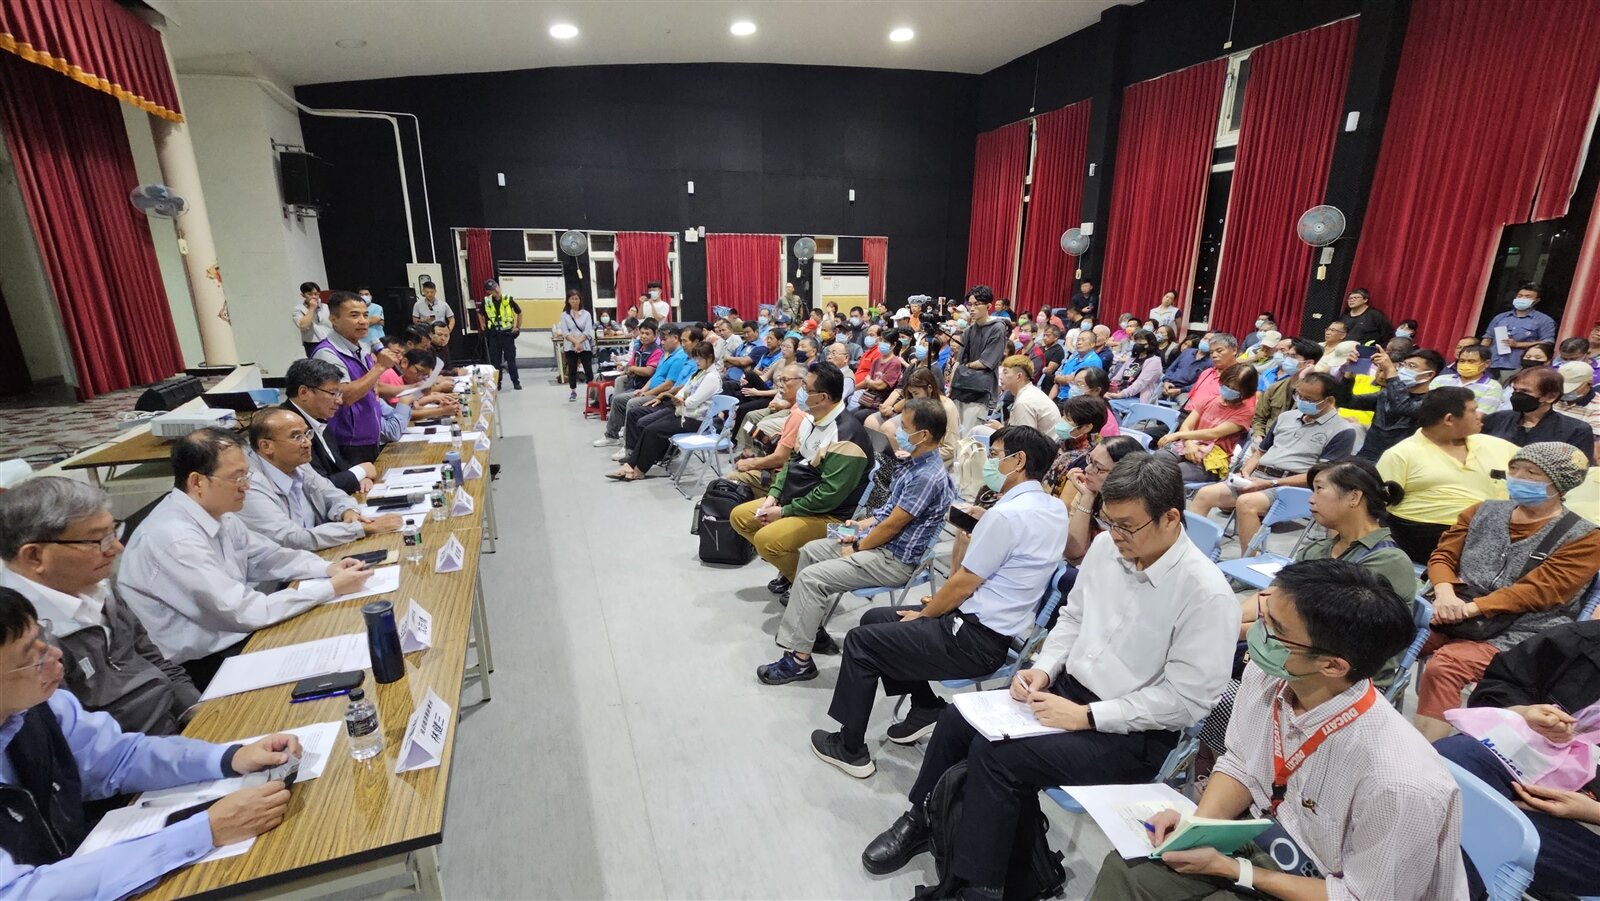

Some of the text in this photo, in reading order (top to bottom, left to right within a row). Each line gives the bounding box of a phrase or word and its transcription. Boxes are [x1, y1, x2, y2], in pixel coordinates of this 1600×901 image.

[1322, 707, 1360, 735] DUCATI
[1274, 720, 1283, 758] DUCATI
[1285, 749, 1306, 771] DUCATI
